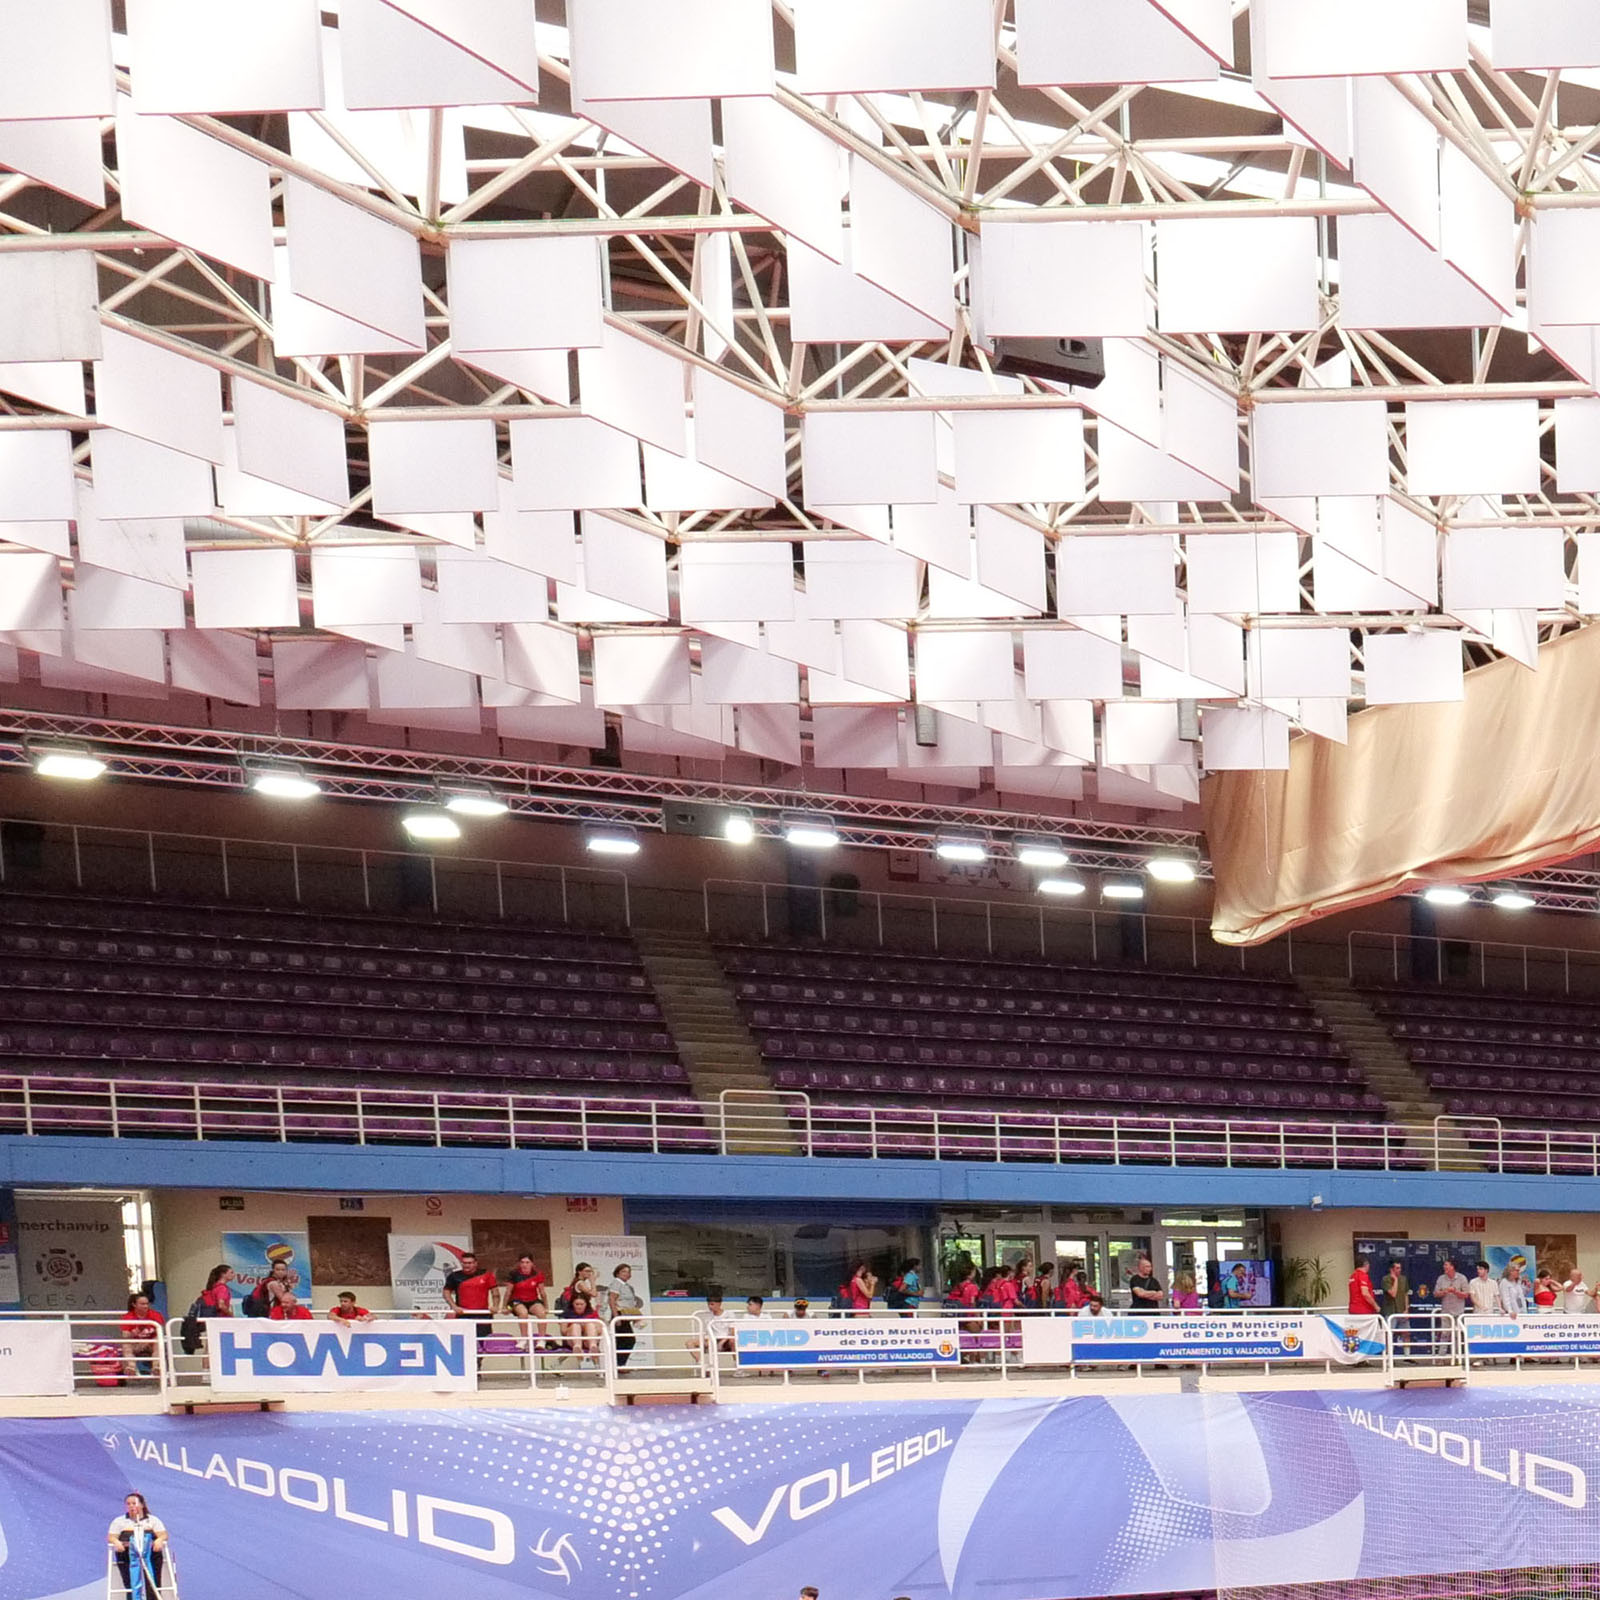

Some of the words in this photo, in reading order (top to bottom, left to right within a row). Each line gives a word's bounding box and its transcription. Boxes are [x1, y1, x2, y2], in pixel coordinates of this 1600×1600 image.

[738, 1330, 810, 1347] FMD
[814, 1328, 885, 1337] Fundación
[889, 1328, 956, 1337] Municipal
[1072, 1320, 1148, 1338] FMD
[1154, 1321, 1225, 1330] Fundación
[1232, 1320, 1303, 1330] Municipal
[1183, 1330, 1200, 1339] de
[1205, 1330, 1278, 1339] Deportes
[1468, 1324, 1520, 1338] FMD
[840, 1338, 856, 1346] de
[860, 1337, 931, 1346] Deportes
[220, 1332, 465, 1377] HOWDEN
[818, 1353, 876, 1361] AYUNTAMIENTO
[878, 1352, 888, 1361] DE
[890, 1352, 933, 1360] VALLADOLID
[1160, 1347, 1221, 1356] AYUNTAMIENTO
[1223, 1347, 1233, 1355] DE
[1235, 1346, 1281, 1355] VALLADOLID
[1347, 1406, 1586, 1508] VALLADOLID
[711, 1427, 953, 1545] VOLEIBOL
[129, 1436, 515, 1565] VALLADOLID
